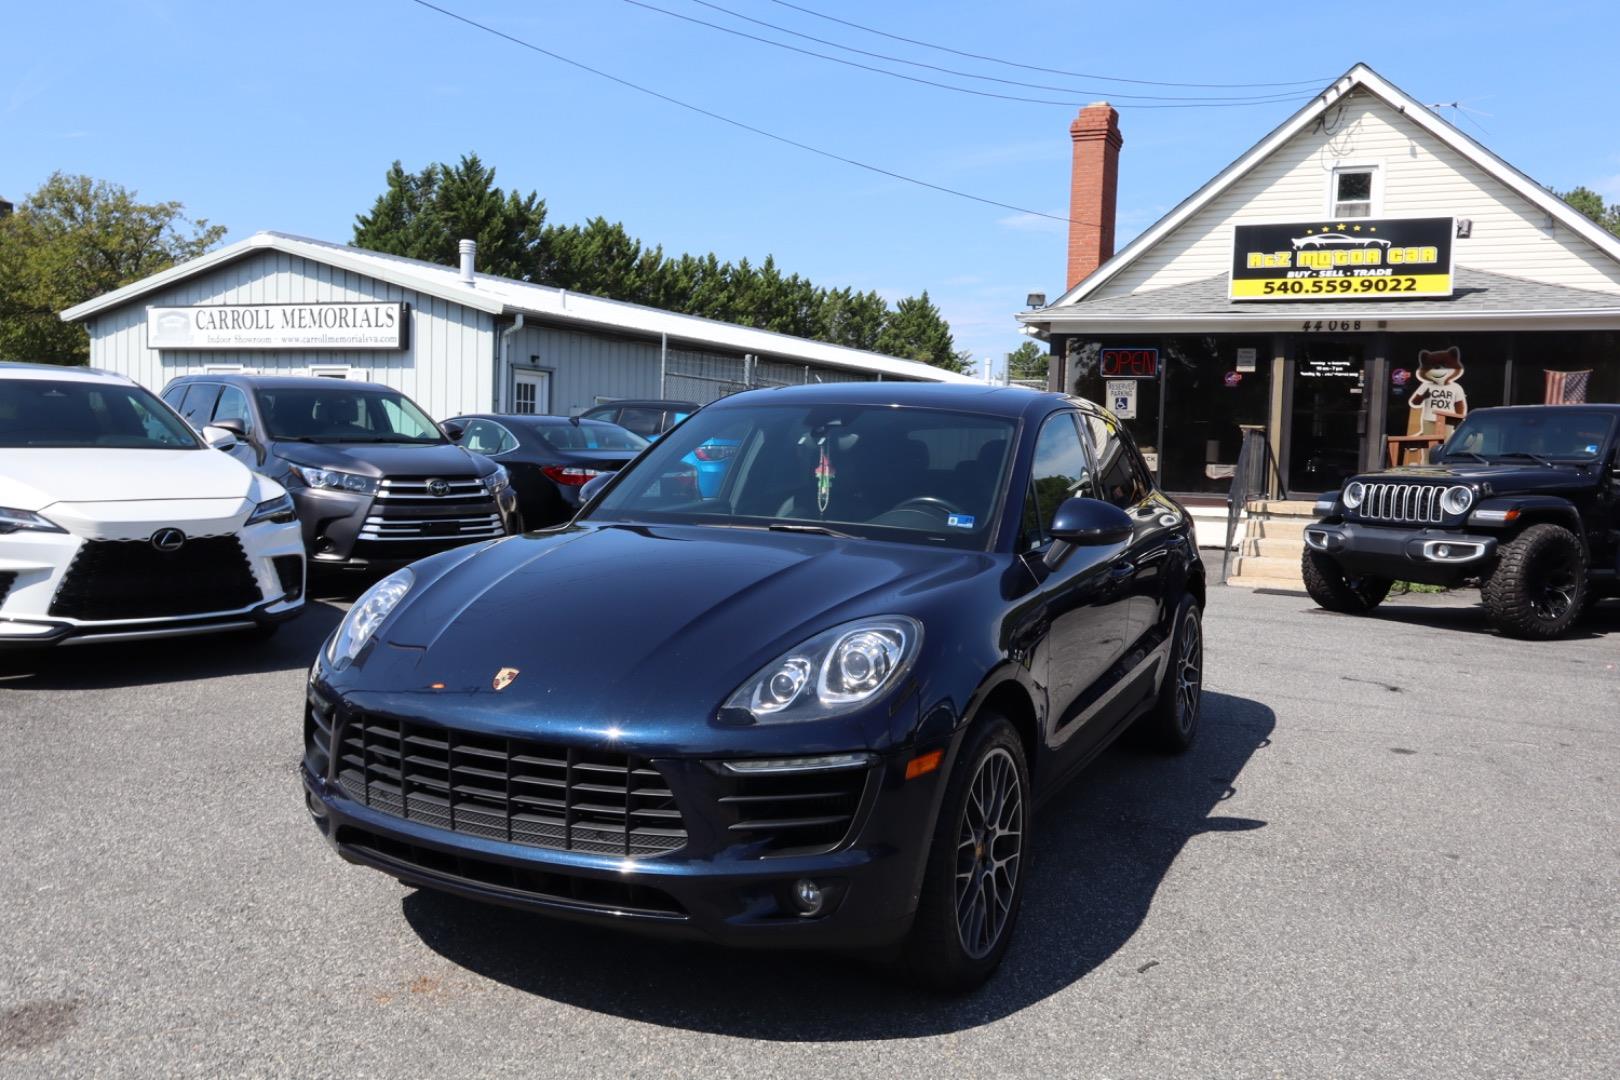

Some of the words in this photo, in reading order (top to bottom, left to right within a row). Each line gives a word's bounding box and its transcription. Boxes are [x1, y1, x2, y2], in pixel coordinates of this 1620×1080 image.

[1287, 270, 1312, 278] BUY
[1319, 269, 1345, 277] SELL
[1353, 268, 1392, 276] TRADE
[1263, 277, 1417, 294] 540.559.9022
[195, 309, 274, 330] CARROLL
[281, 306, 395, 329] MEMORIALS
[206, 334, 232, 344] Indoor
[234, 334, 272, 344] Showroom
[1103, 351, 1155, 375] OPEN
[1431, 390, 1453, 399] CAR
[1430, 399, 1451, 409] FOX
